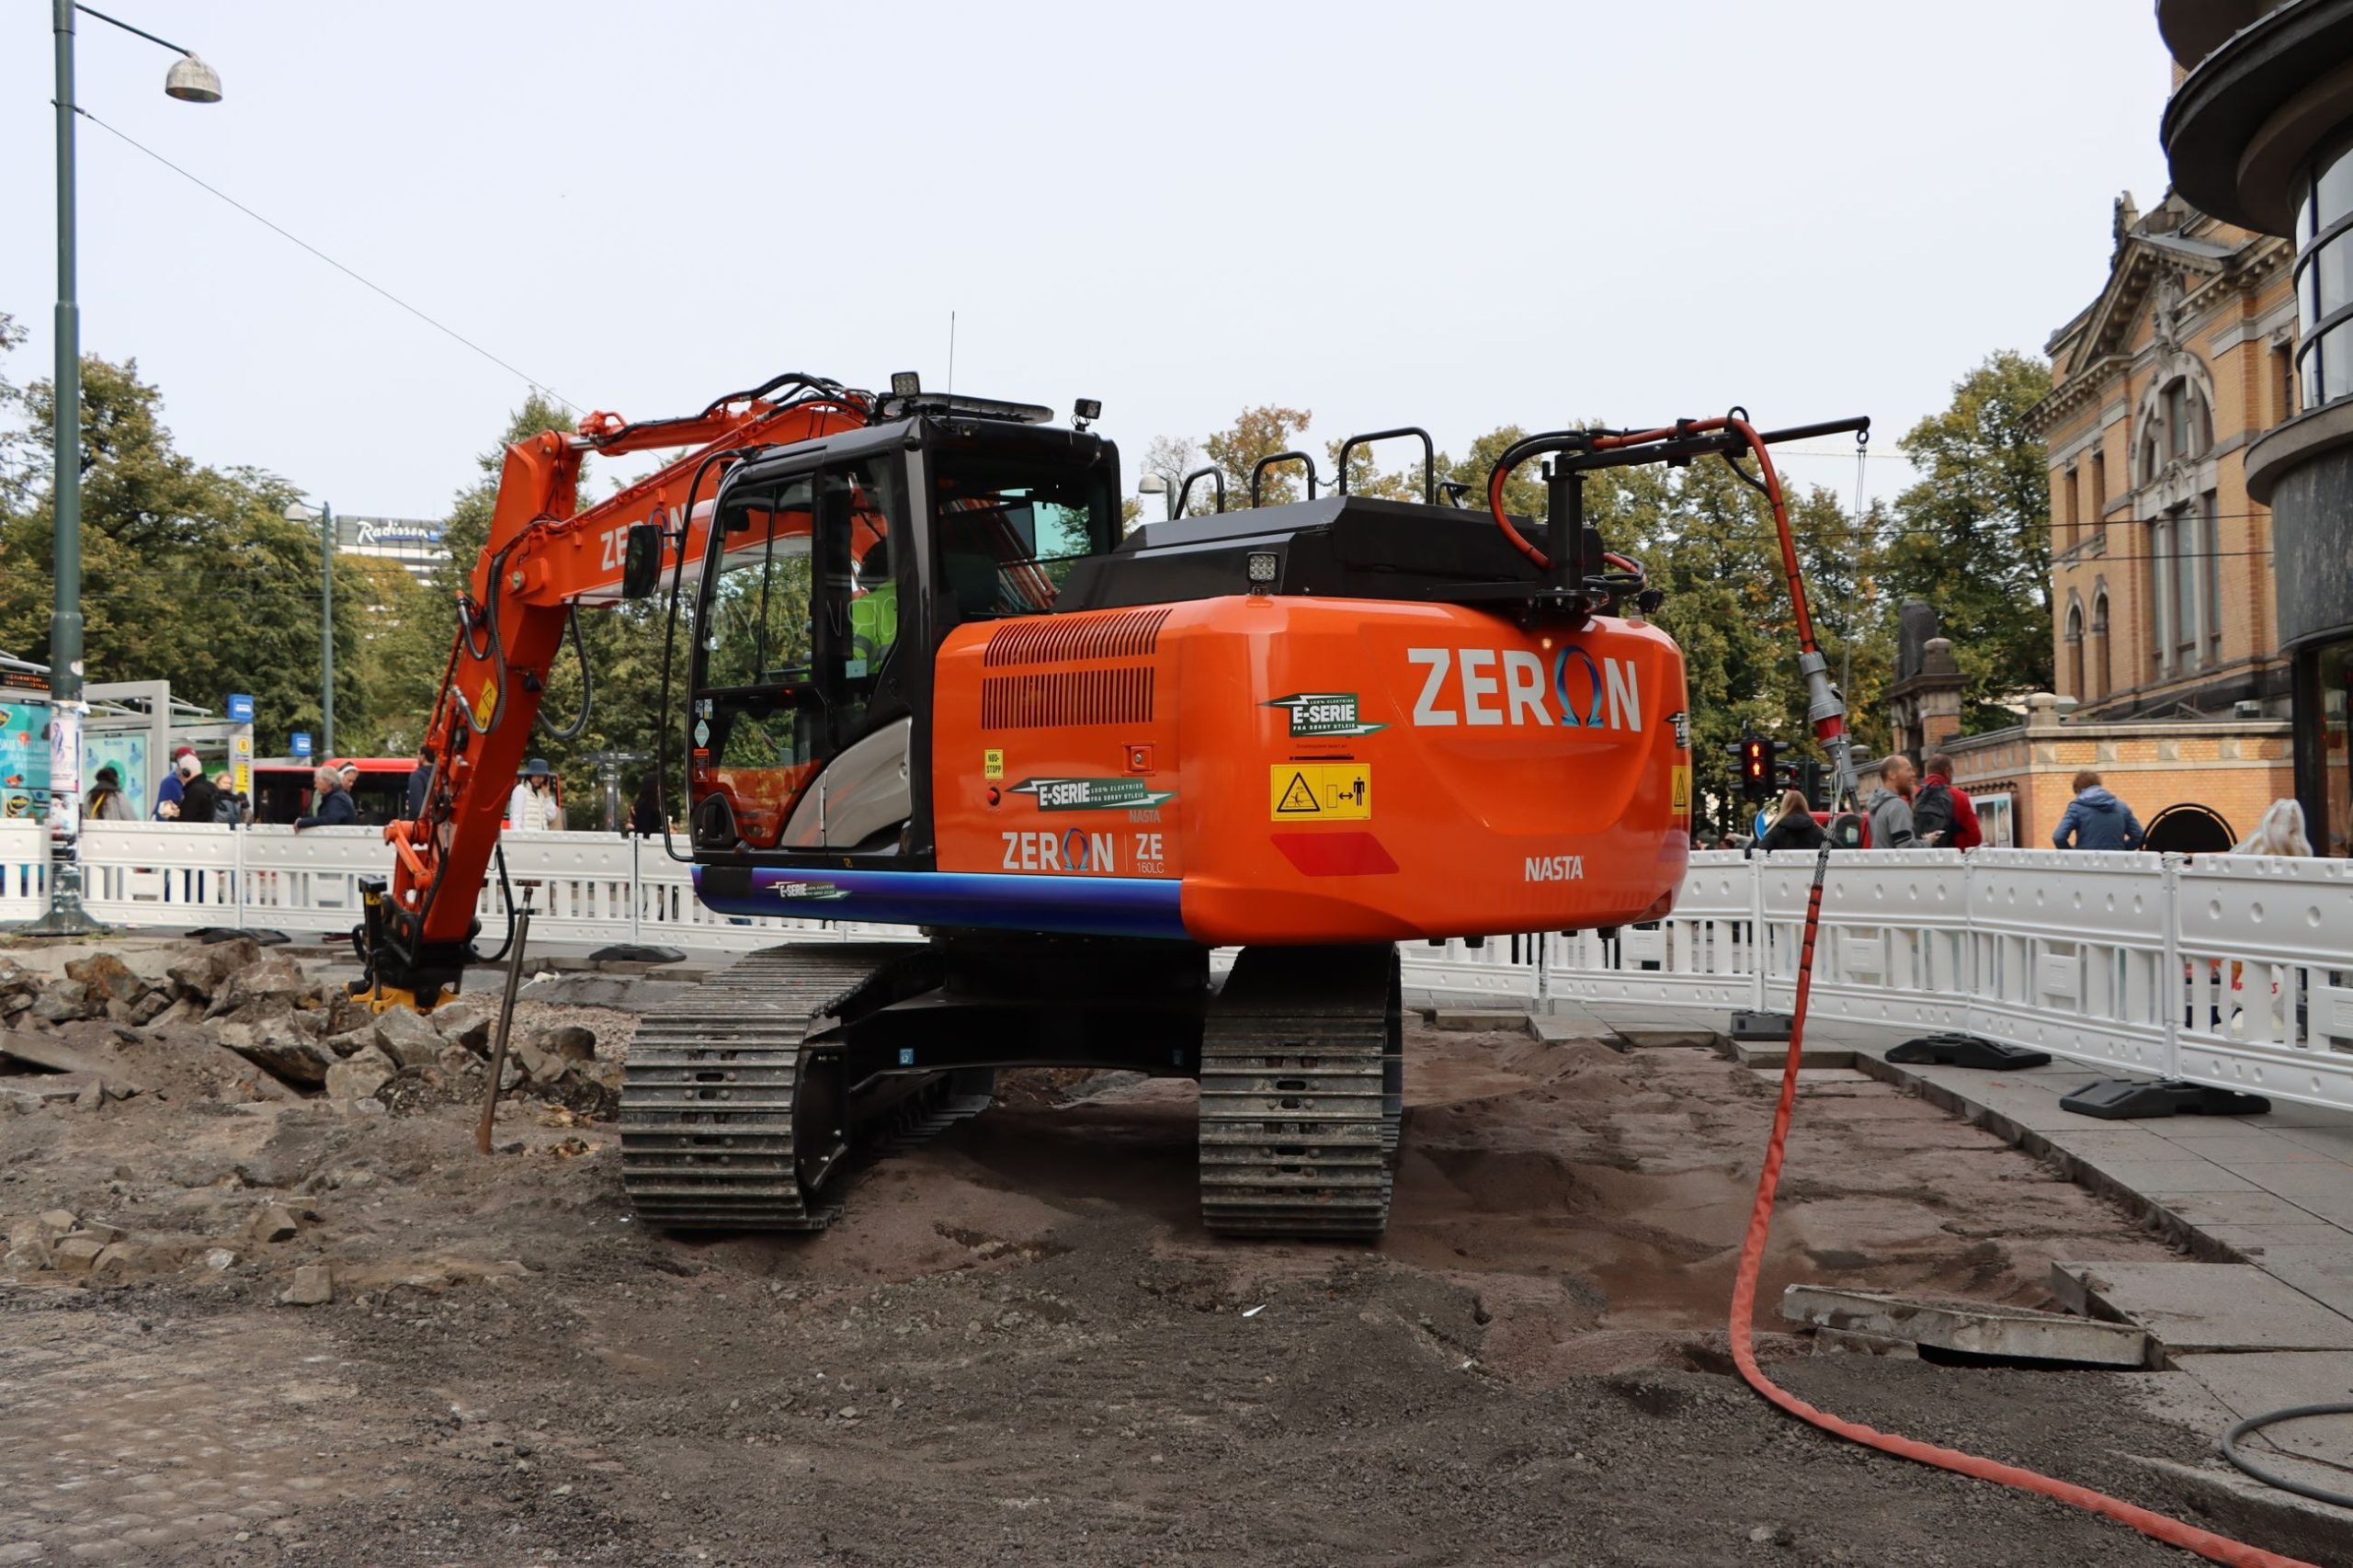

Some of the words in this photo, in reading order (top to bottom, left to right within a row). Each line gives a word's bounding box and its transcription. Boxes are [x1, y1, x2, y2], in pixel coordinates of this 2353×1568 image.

[1293, 704, 1356, 724] E-SERIE
[986, 765, 1001, 773] STOPP
[1040, 782, 1090, 806] E-SERIE
[1110, 783, 1143, 792] ELEKTRISK
[1129, 810, 1162, 823] NASTA
[1135, 834, 1164, 859] ZE
[1137, 862, 1164, 874] 160LC
[1525, 855, 1584, 882] NASTA
[779, 883, 807, 898] E-SERIE
